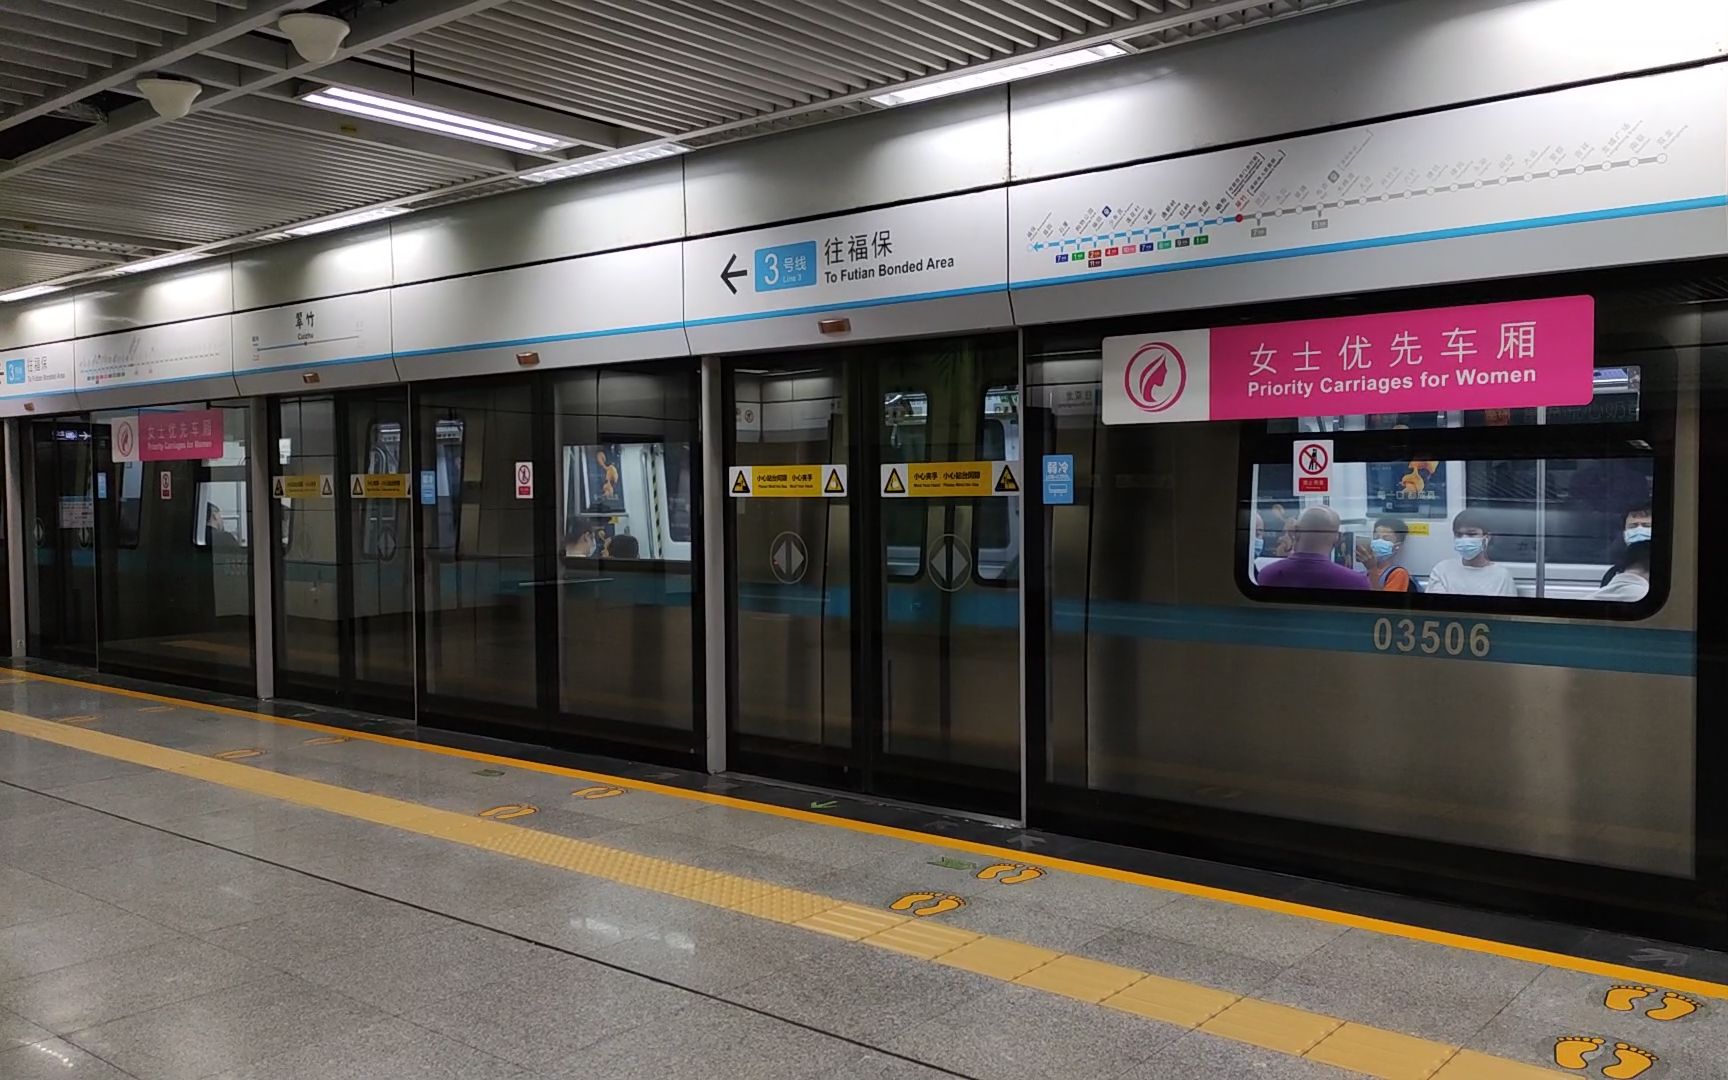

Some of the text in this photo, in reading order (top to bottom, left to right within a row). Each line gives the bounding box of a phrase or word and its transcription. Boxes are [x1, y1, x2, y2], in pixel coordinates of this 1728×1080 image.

[824, 230, 893, 265] 往福保
[764, 253, 780, 285] 3
[782, 256, 807, 273] 号线
[824, 256, 954, 284] To Futian Bonded Area
[295, 311, 315, 330] 翠竹
[1248, 321, 1535, 376] 女士优先车厢
[1247, 366, 1536, 400] Priority Carriages for Women
[1373, 618, 1491, 658] 03506
